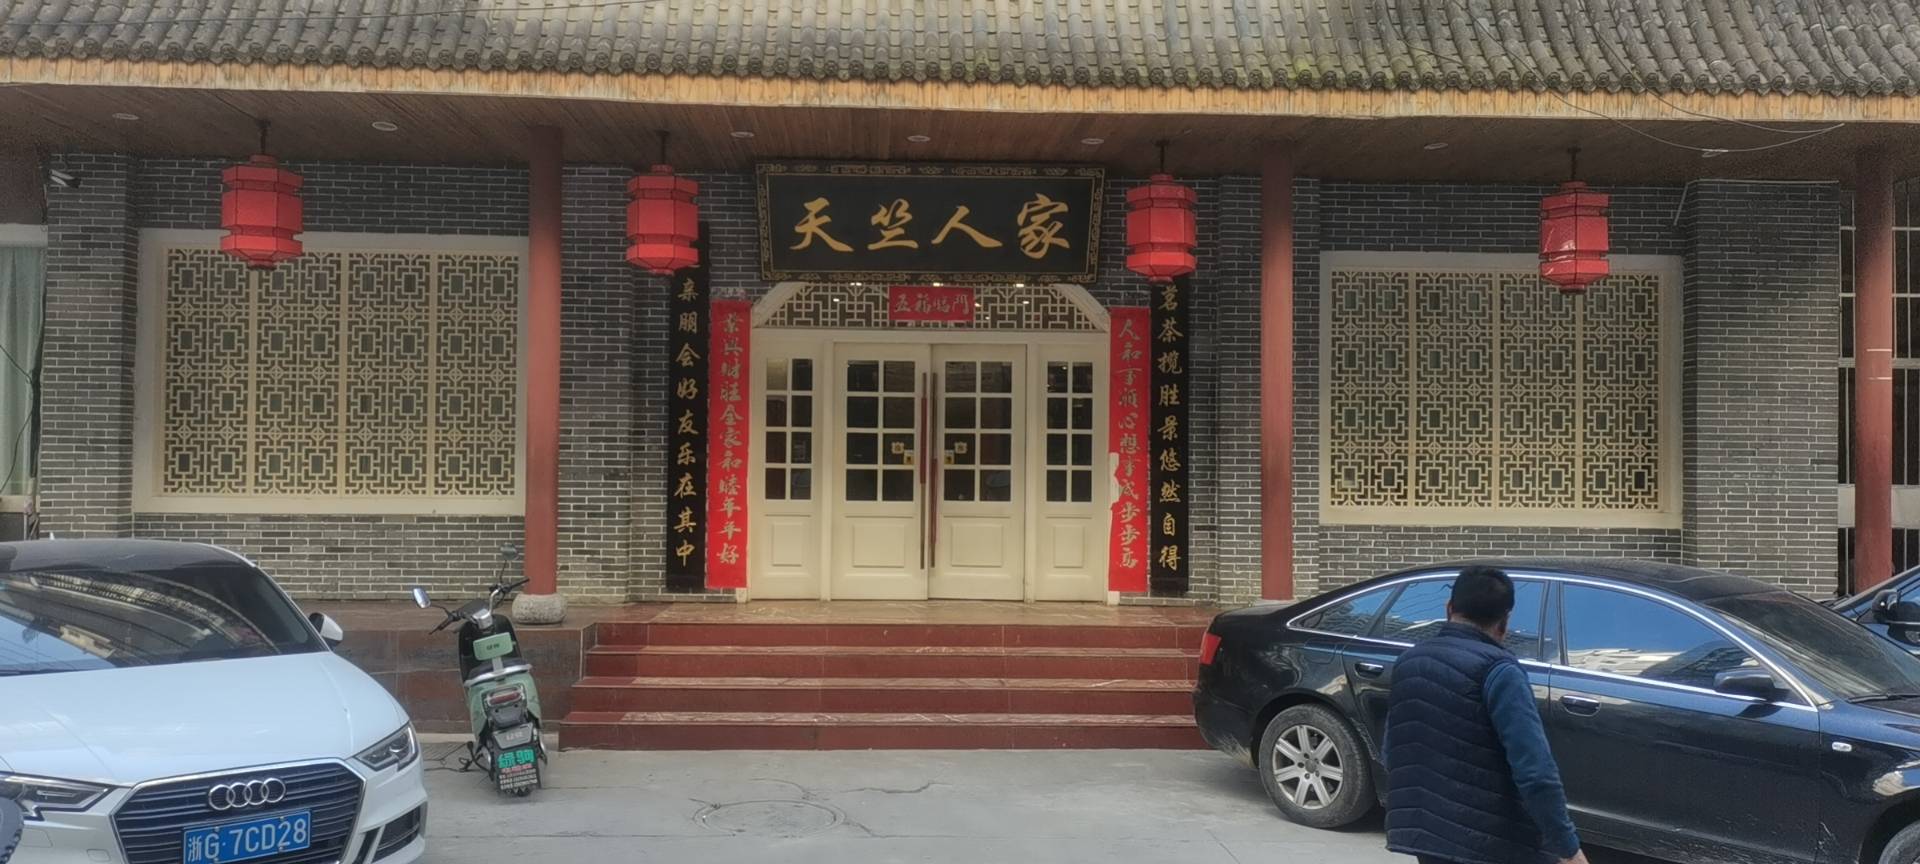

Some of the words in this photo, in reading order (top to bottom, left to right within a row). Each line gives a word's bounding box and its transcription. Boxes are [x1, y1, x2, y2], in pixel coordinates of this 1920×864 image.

[788, 193, 1071, 260] 天竺人家
[673, 277, 701, 568] 亲朋会好友乐在其中
[1157, 285, 1183, 572] 茗茶揽胜景悠然自得
